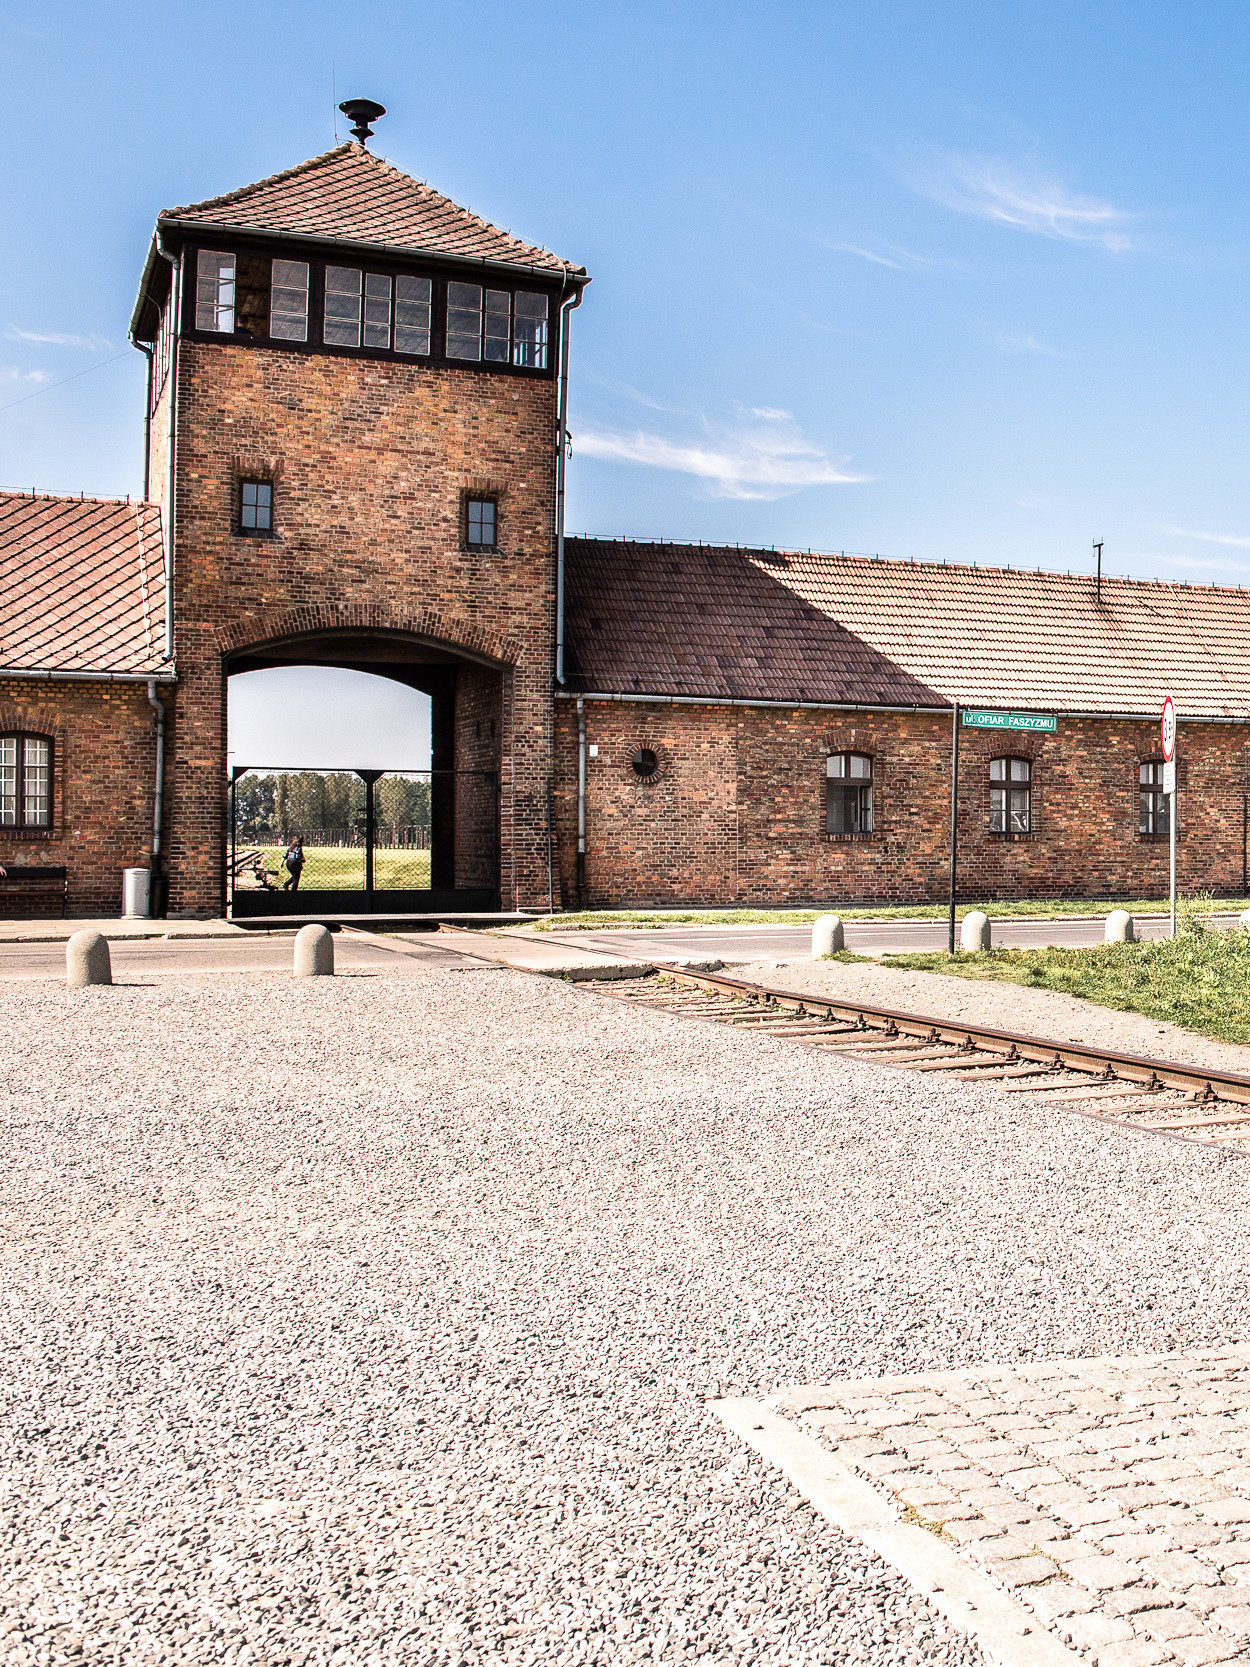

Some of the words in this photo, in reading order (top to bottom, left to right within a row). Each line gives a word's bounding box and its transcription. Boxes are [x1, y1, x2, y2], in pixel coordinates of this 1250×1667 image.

[965, 714, 975, 723] ul.
[978, 715, 1004, 724] OFIAR
[1008, 717, 1053, 728] FASZYZMU
